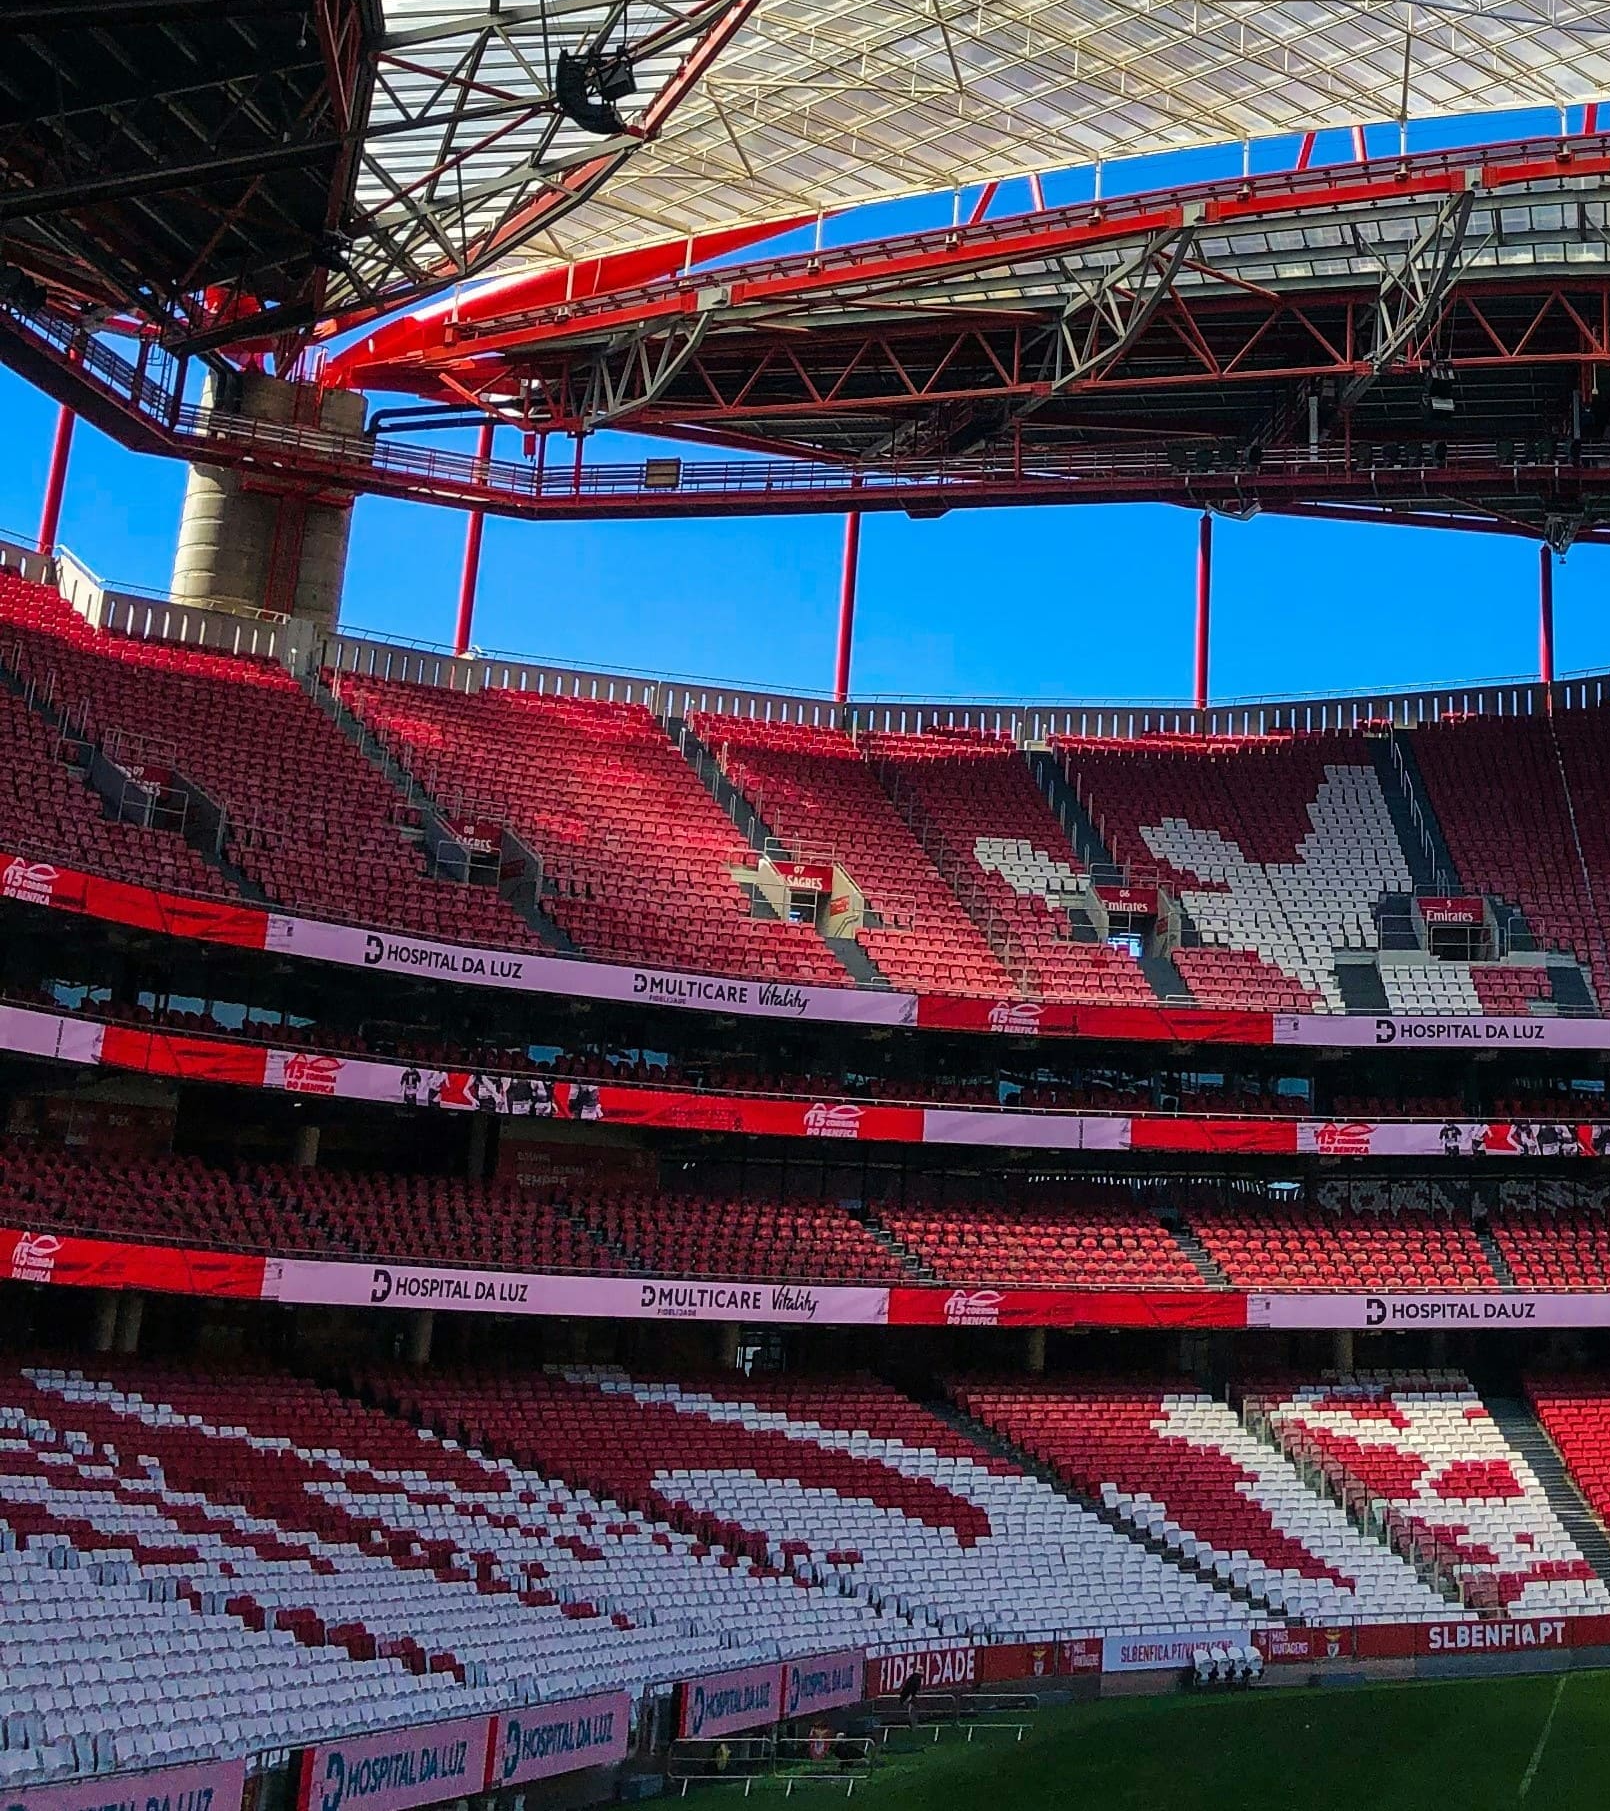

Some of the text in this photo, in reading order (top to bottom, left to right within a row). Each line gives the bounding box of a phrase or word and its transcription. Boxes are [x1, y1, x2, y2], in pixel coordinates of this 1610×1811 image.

[787, 876, 823, 890] SAGRES
[1102, 899, 1149, 913] Emirates
[1426, 909, 1474, 922] Emirates
[387, 944, 523, 979] HOSPITAL DA LUZ
[650, 976, 811, 1015] MULTICARE Vitality
[1401, 1024, 1544, 1039] HOSPITAL DA LUZ
[396, 1277, 528, 1302] HOSPITAL DA LUZ
[659, 1288, 820, 1319] MULTICARE Vitality
[1393, 1303, 1480, 1318] HOSPITAL
[880, 1649, 975, 1692] FIDEIDADE
[346, 1741, 467, 1796] HOSPITAL DA LUZ
